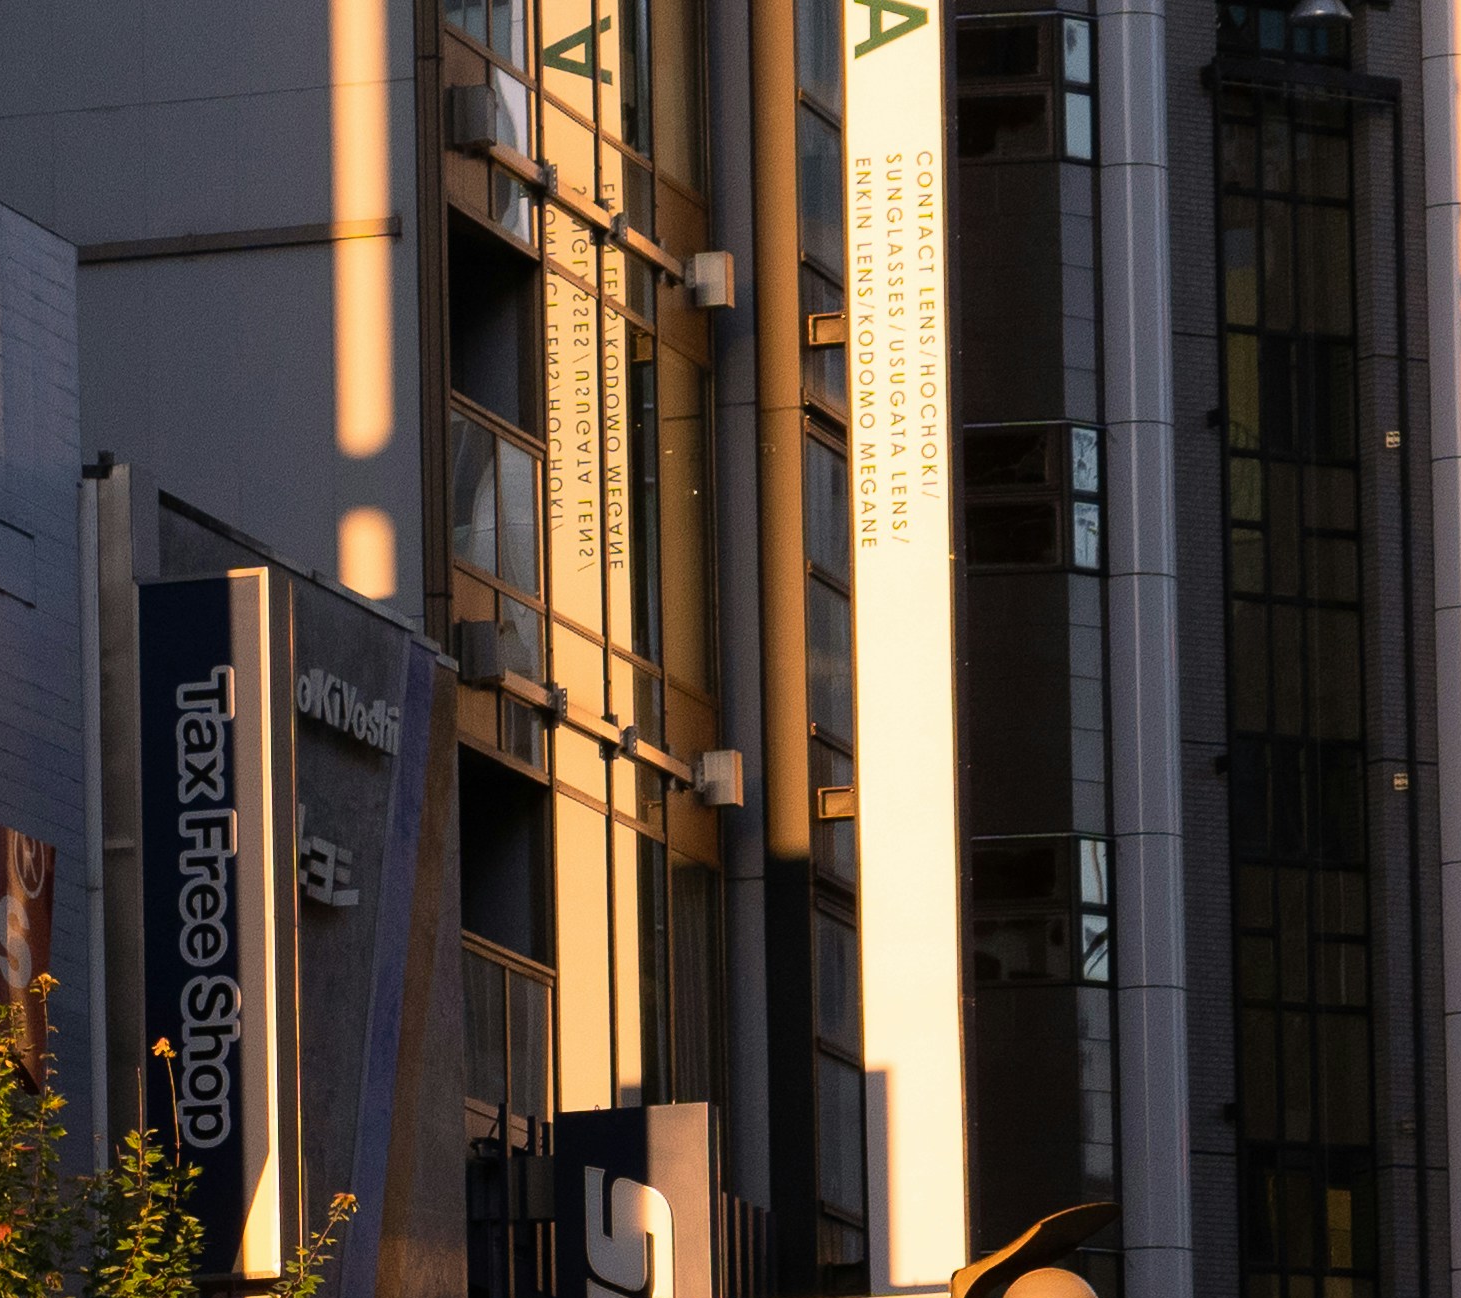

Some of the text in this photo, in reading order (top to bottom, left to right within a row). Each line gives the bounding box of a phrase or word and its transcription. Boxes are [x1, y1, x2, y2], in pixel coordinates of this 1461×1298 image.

[854, 156, 873, 235] ENKIN
[915, 150, 938, 273] CONTACT
[859, 443, 879, 550] MEGANE
[175, 665, 241, 1149] Tax Free Shop
